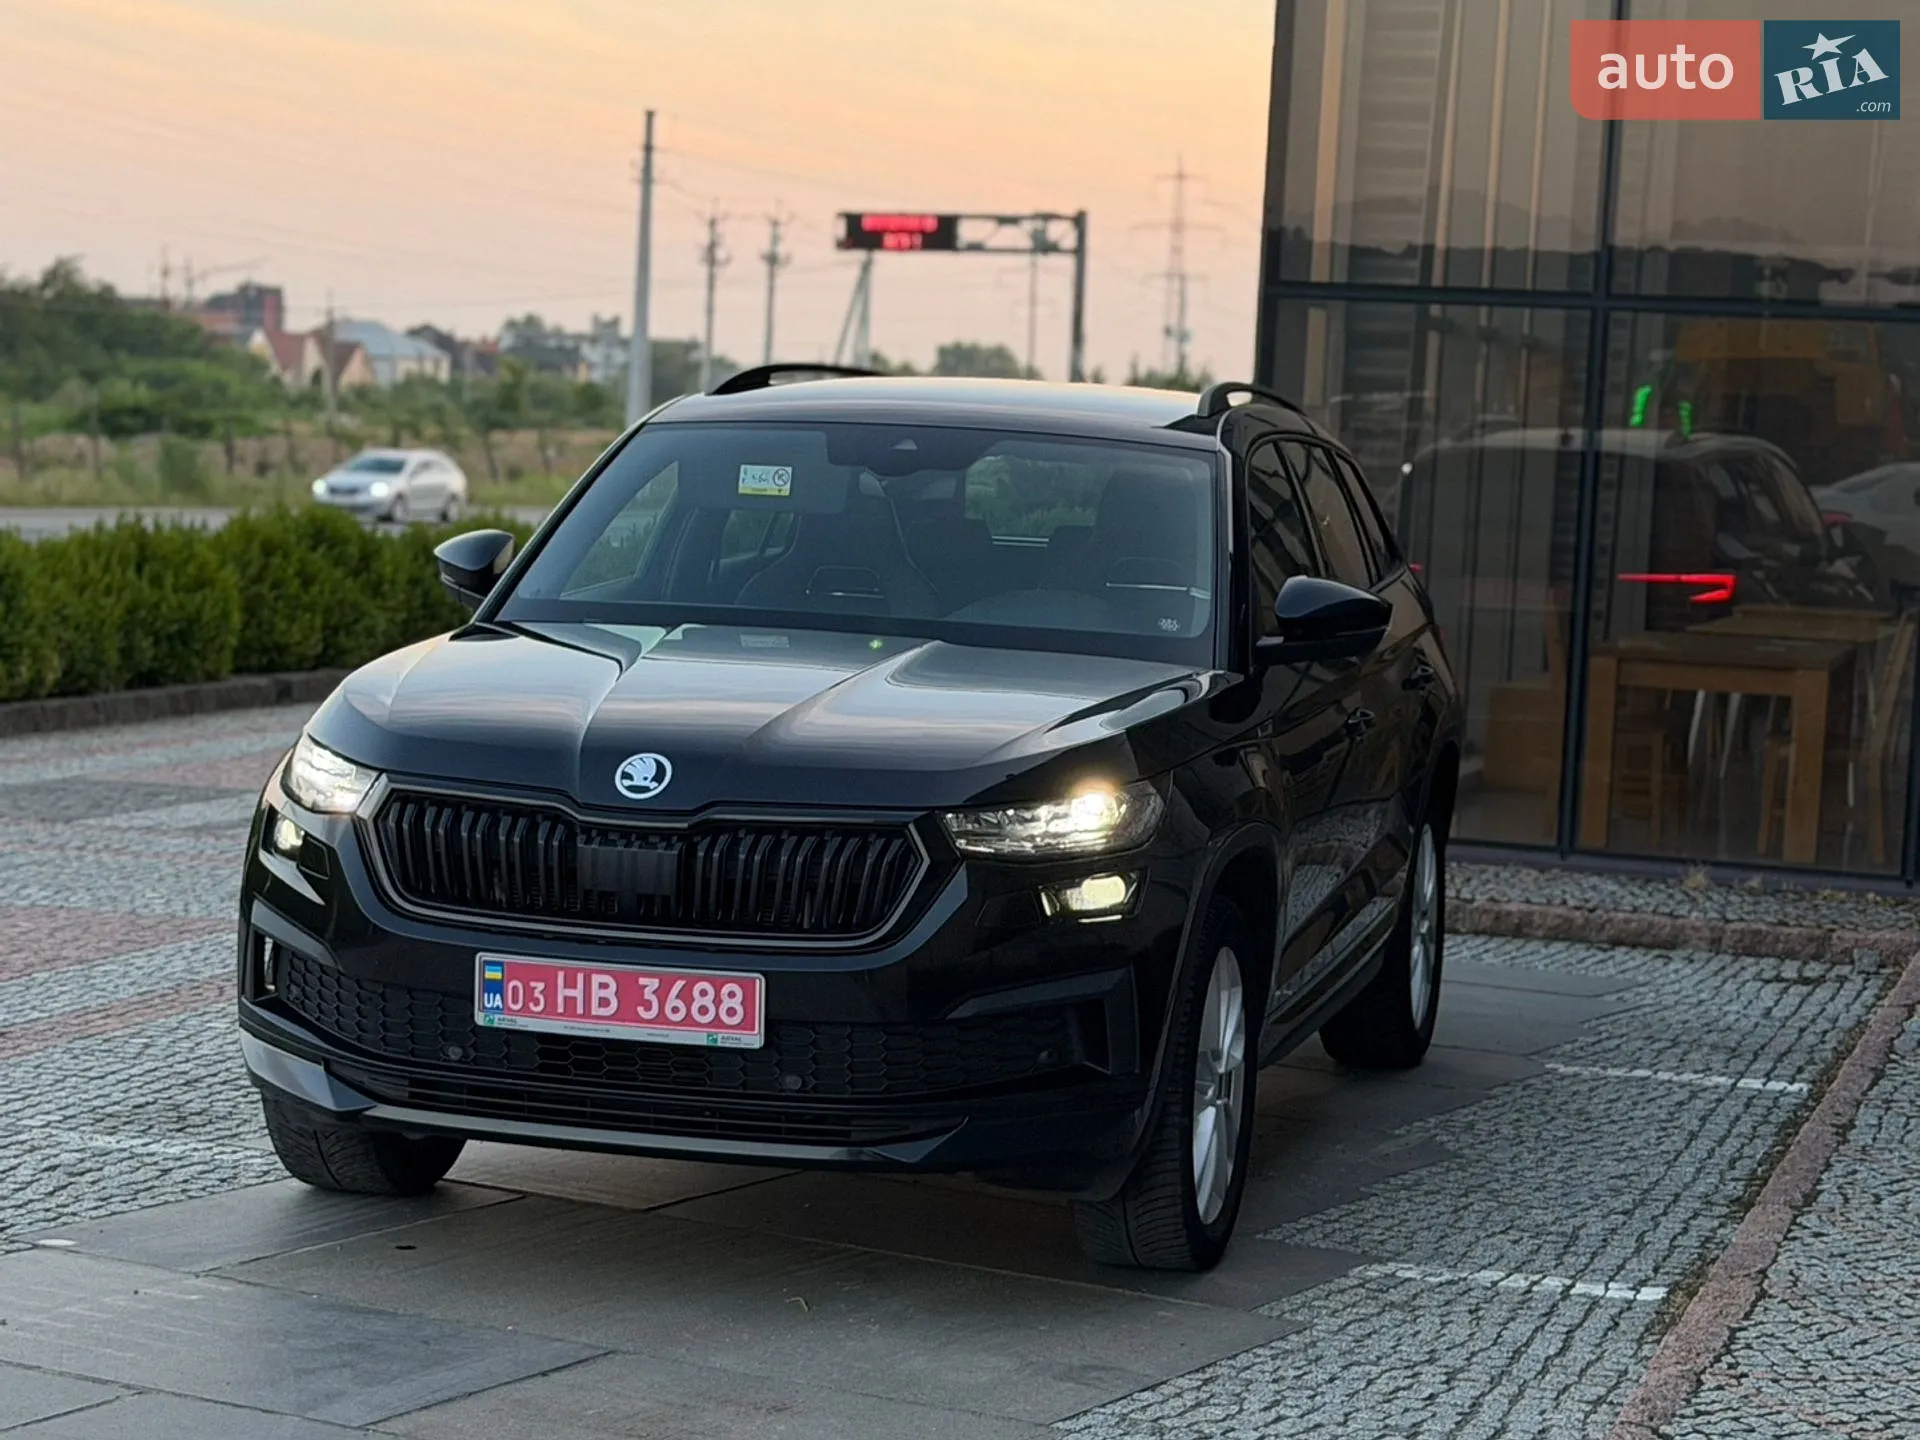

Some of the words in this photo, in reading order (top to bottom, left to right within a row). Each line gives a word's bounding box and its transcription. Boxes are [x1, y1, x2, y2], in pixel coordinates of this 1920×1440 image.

[484, 992, 503, 1009] UA
[507, 979, 546, 1012] 03
[557, 970, 619, 1016] HB
[636, 977, 744, 1026] 3688
